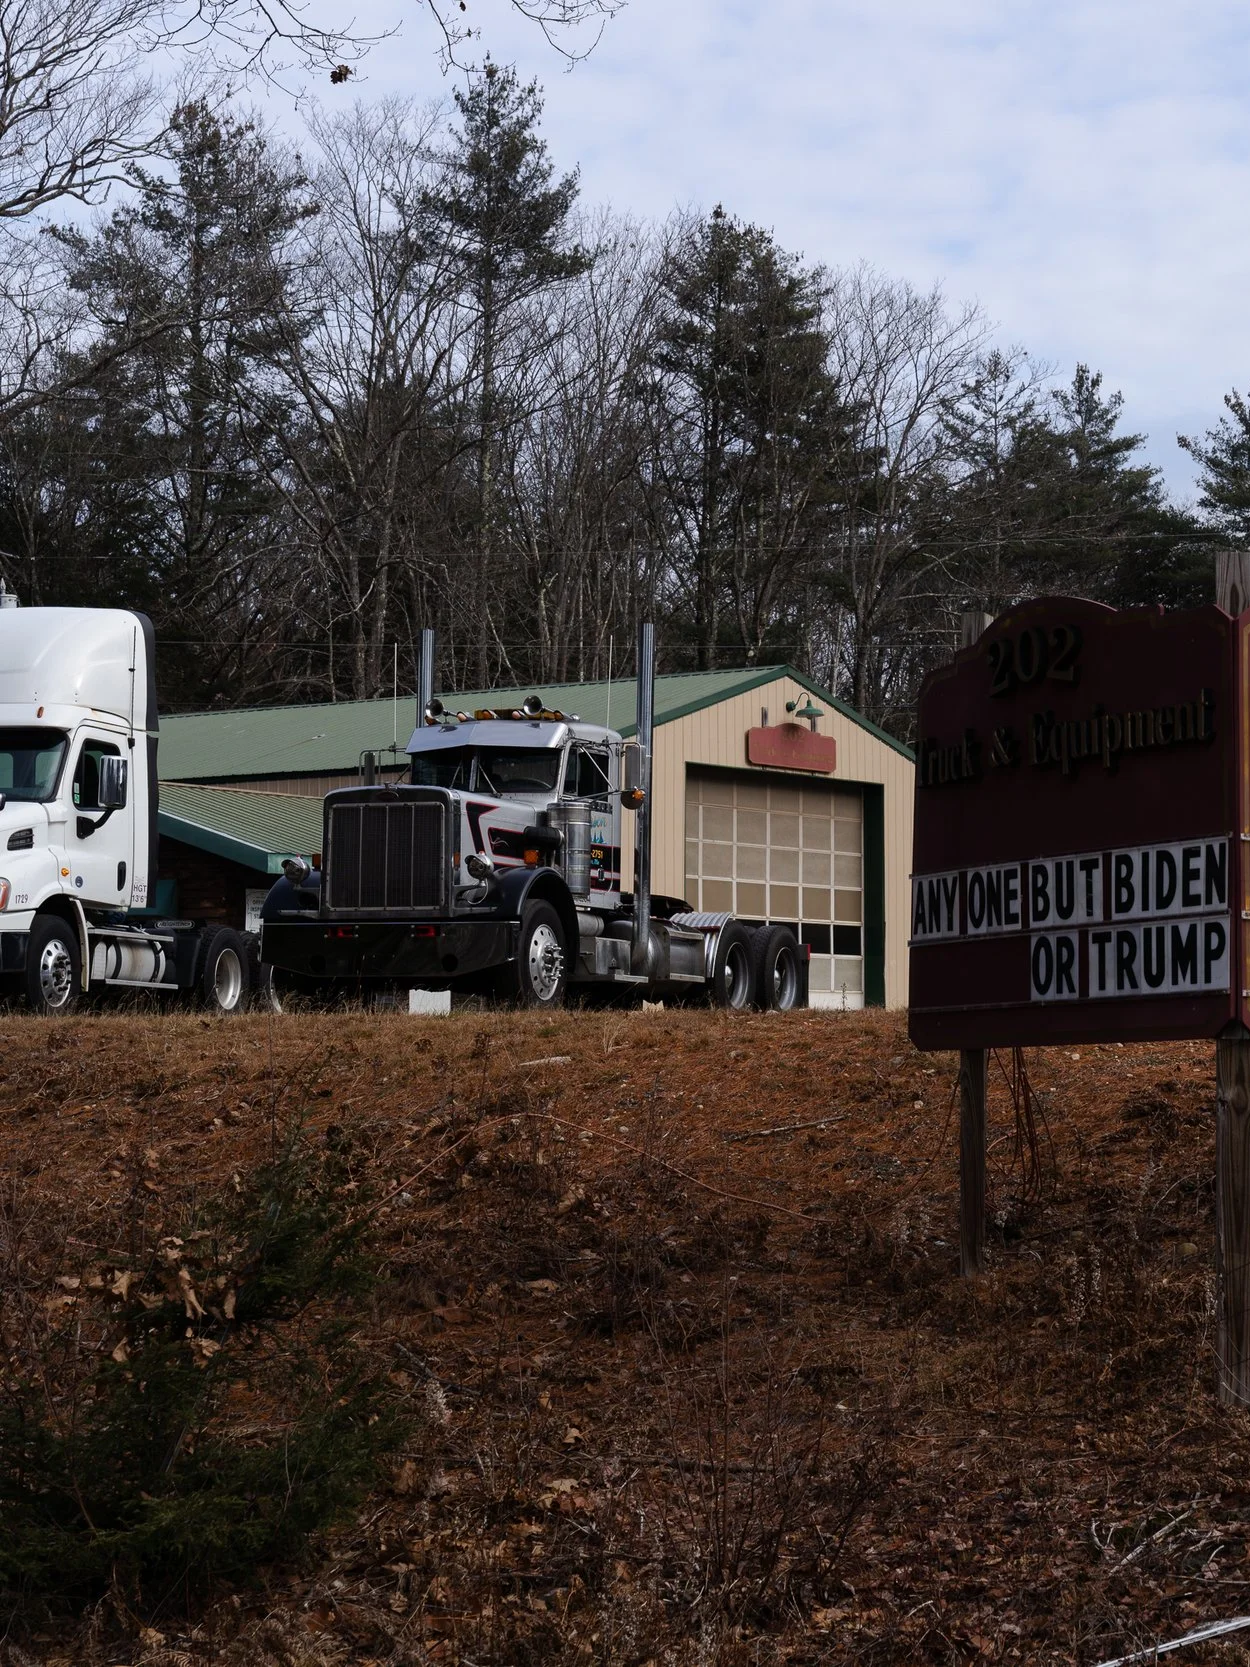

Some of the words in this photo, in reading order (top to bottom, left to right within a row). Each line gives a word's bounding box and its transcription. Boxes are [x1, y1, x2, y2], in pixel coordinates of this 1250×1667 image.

[988, 623, 1083, 697] 202
[917, 729, 982, 787] Truck
[991, 726, 1019, 769] &
[1029, 688, 1217, 775] Equipment
[15, 893, 29, 904] 1729
[133, 884, 147, 893] HGT
[1031, 856, 1100, 923] BUT
[1114, 842, 1227, 914] BIDEN
[1031, 934, 1076, 996] OR
[1091, 921, 1227, 991] TRUMP
